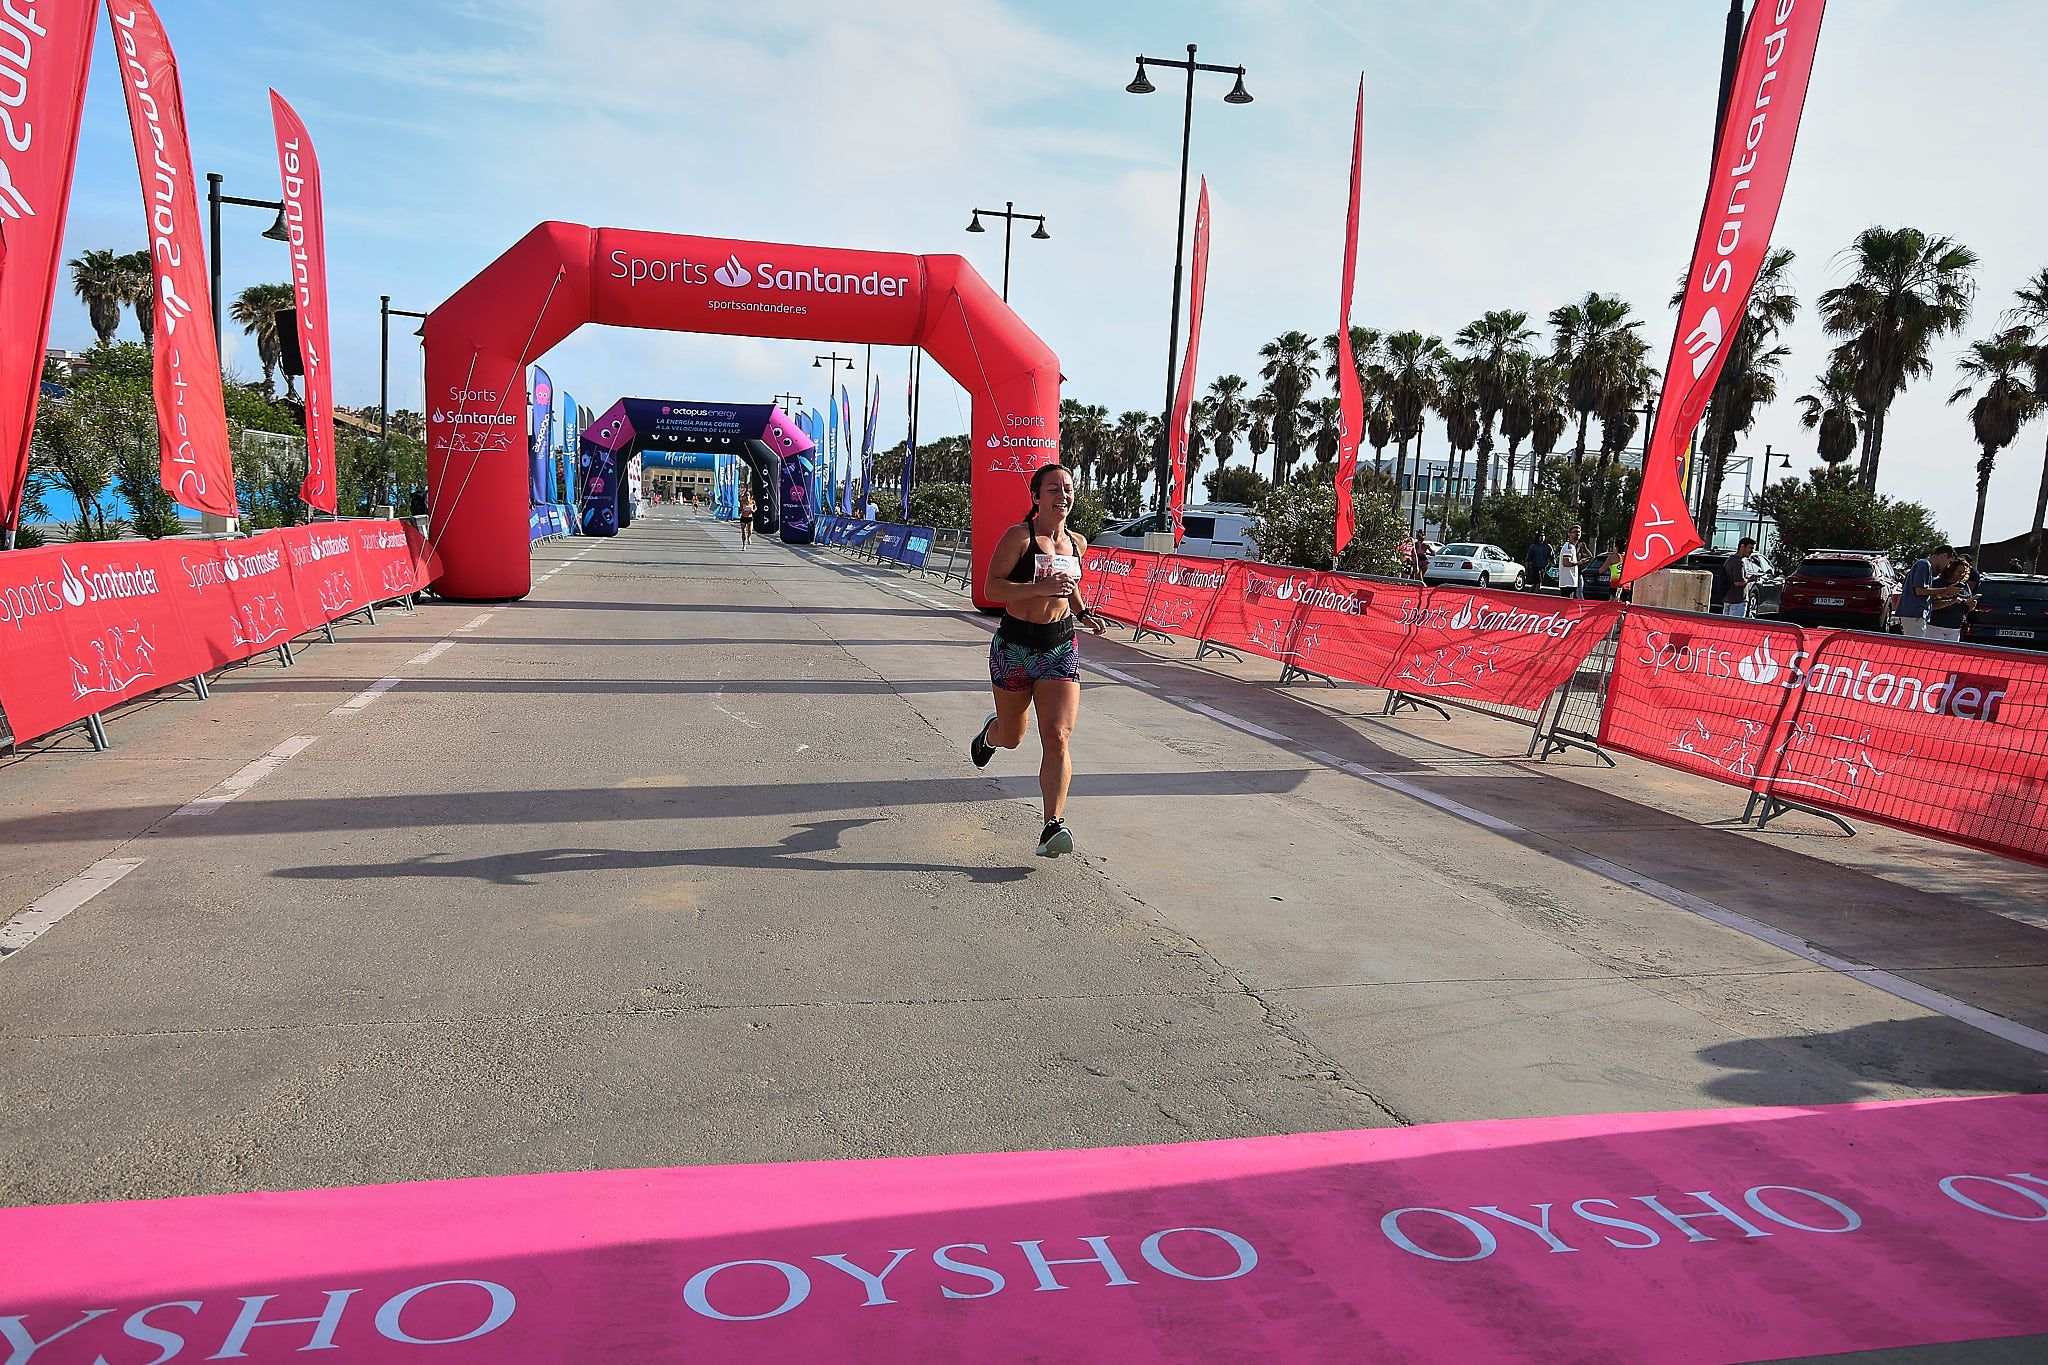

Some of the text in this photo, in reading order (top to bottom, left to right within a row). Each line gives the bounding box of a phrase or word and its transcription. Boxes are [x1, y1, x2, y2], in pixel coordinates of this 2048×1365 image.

[609, 250, 909, 297] Sports Santander
[708, 299, 807, 315] sportssantander.es
[449, 386, 497, 404] Sports
[446, 410, 517, 425] Santander
[666, 418, 692, 427] ENERGÍA
[695, 420, 713, 428] PARA
[713, 421, 740, 429] CORRER
[1006, 413, 1045, 429] Sports
[1002, 435, 1057, 449] Santander
[80, 562, 160, 602] Santander
[1293, 581, 1367, 617] Santander
[1395, 599, 1582, 640] Sports Santander
[1638, 631, 2006, 722] Sports Santander
[1379, 1184, 1863, 1263] OYSHO
[682, 1226, 1258, 1321] OYSHO
